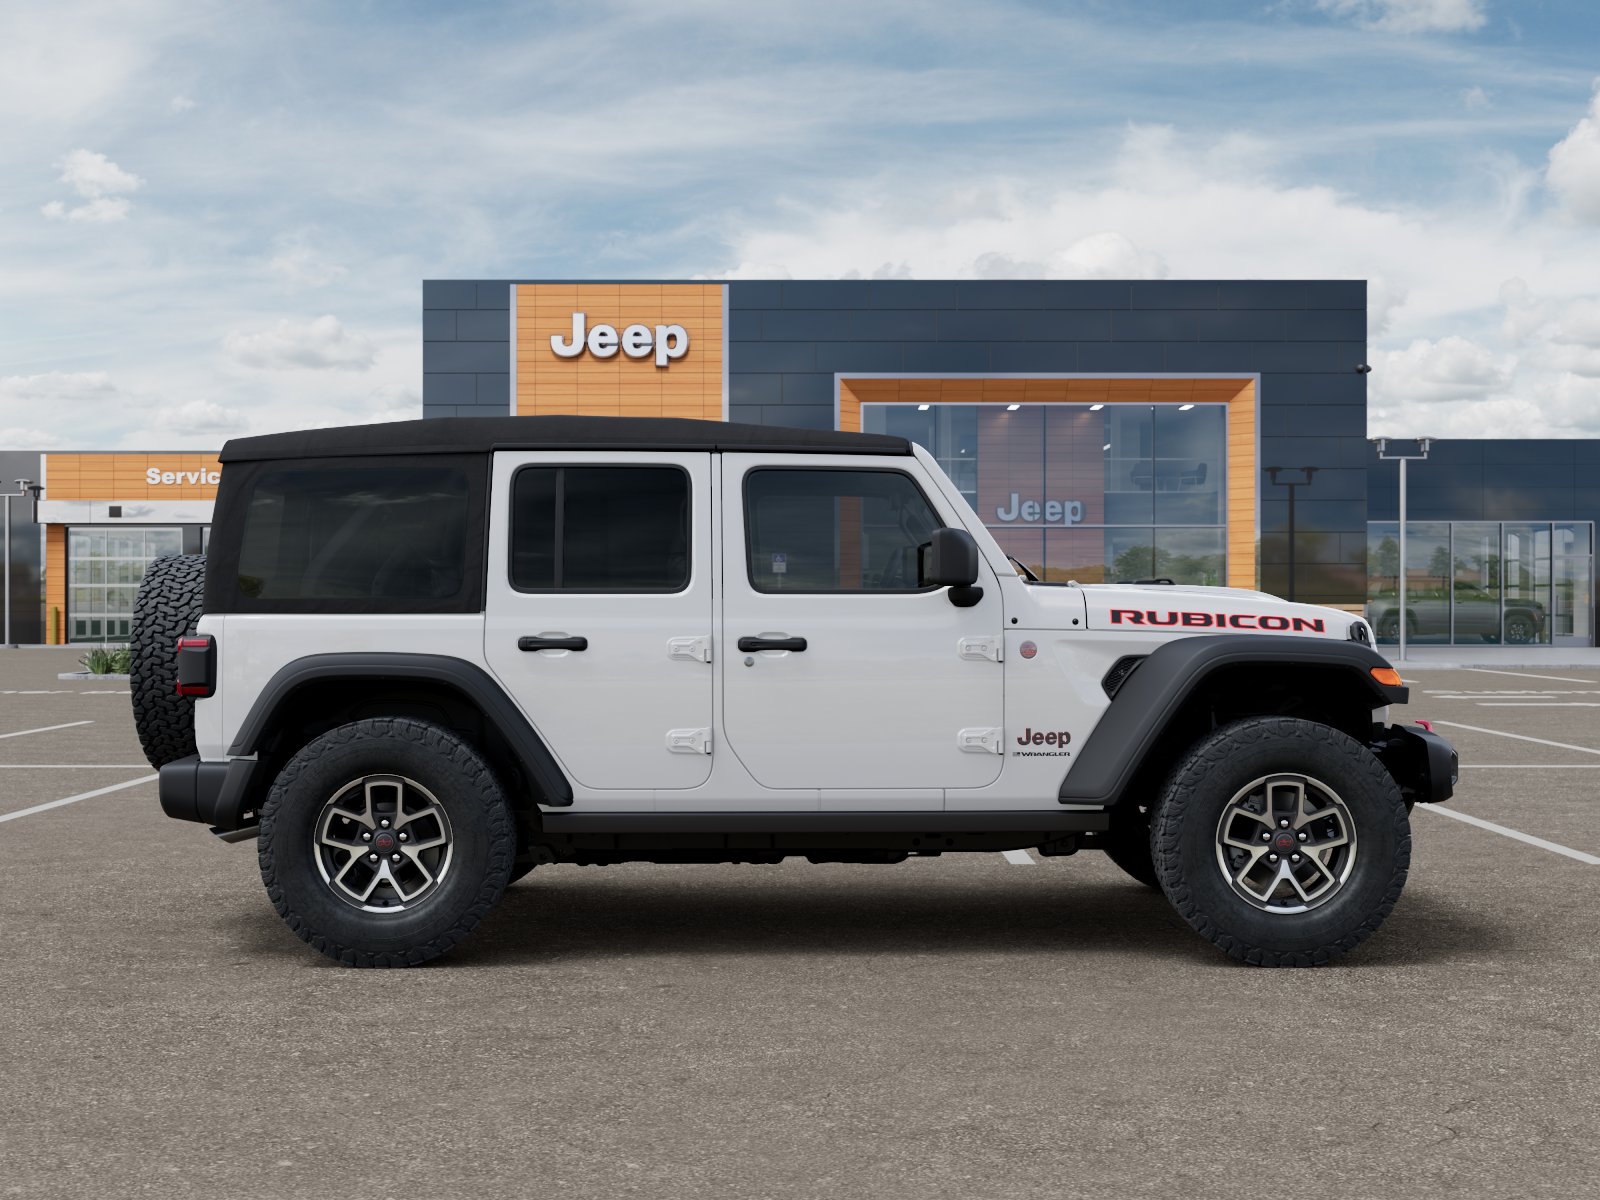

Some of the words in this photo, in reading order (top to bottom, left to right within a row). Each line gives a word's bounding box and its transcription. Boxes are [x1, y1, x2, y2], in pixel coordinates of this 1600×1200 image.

[550, 311, 690, 367] Jeep
[146, 467, 221, 485] Servic
[996, 492, 1084, 527] Jeep
[1110, 609, 1325, 633] RUBICON
[1017, 727, 1071, 748] Jeep
